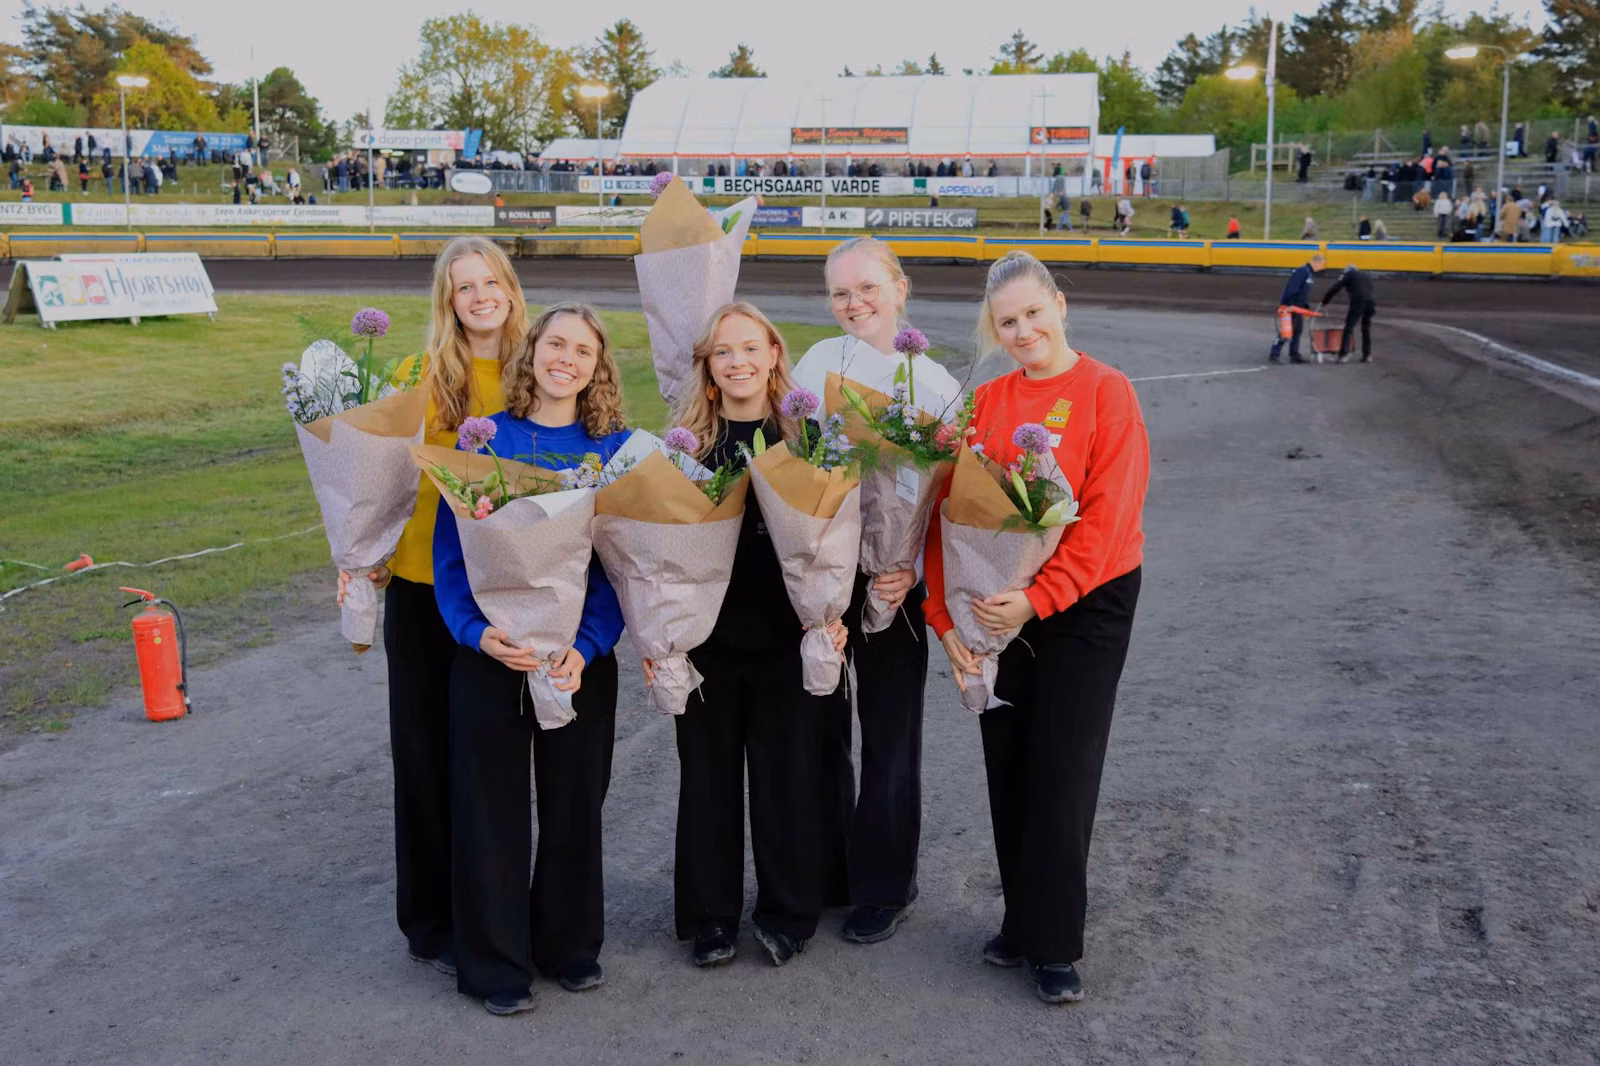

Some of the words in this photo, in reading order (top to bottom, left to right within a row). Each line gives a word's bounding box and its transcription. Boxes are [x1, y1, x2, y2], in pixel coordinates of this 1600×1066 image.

[724, 179, 822, 193] BECHSGAARD
[831, 179, 880, 193] VARDE
[27, 205, 52, 215] BYG
[214, 207, 234, 216] Sven
[508, 211, 531, 219] ROYAL
